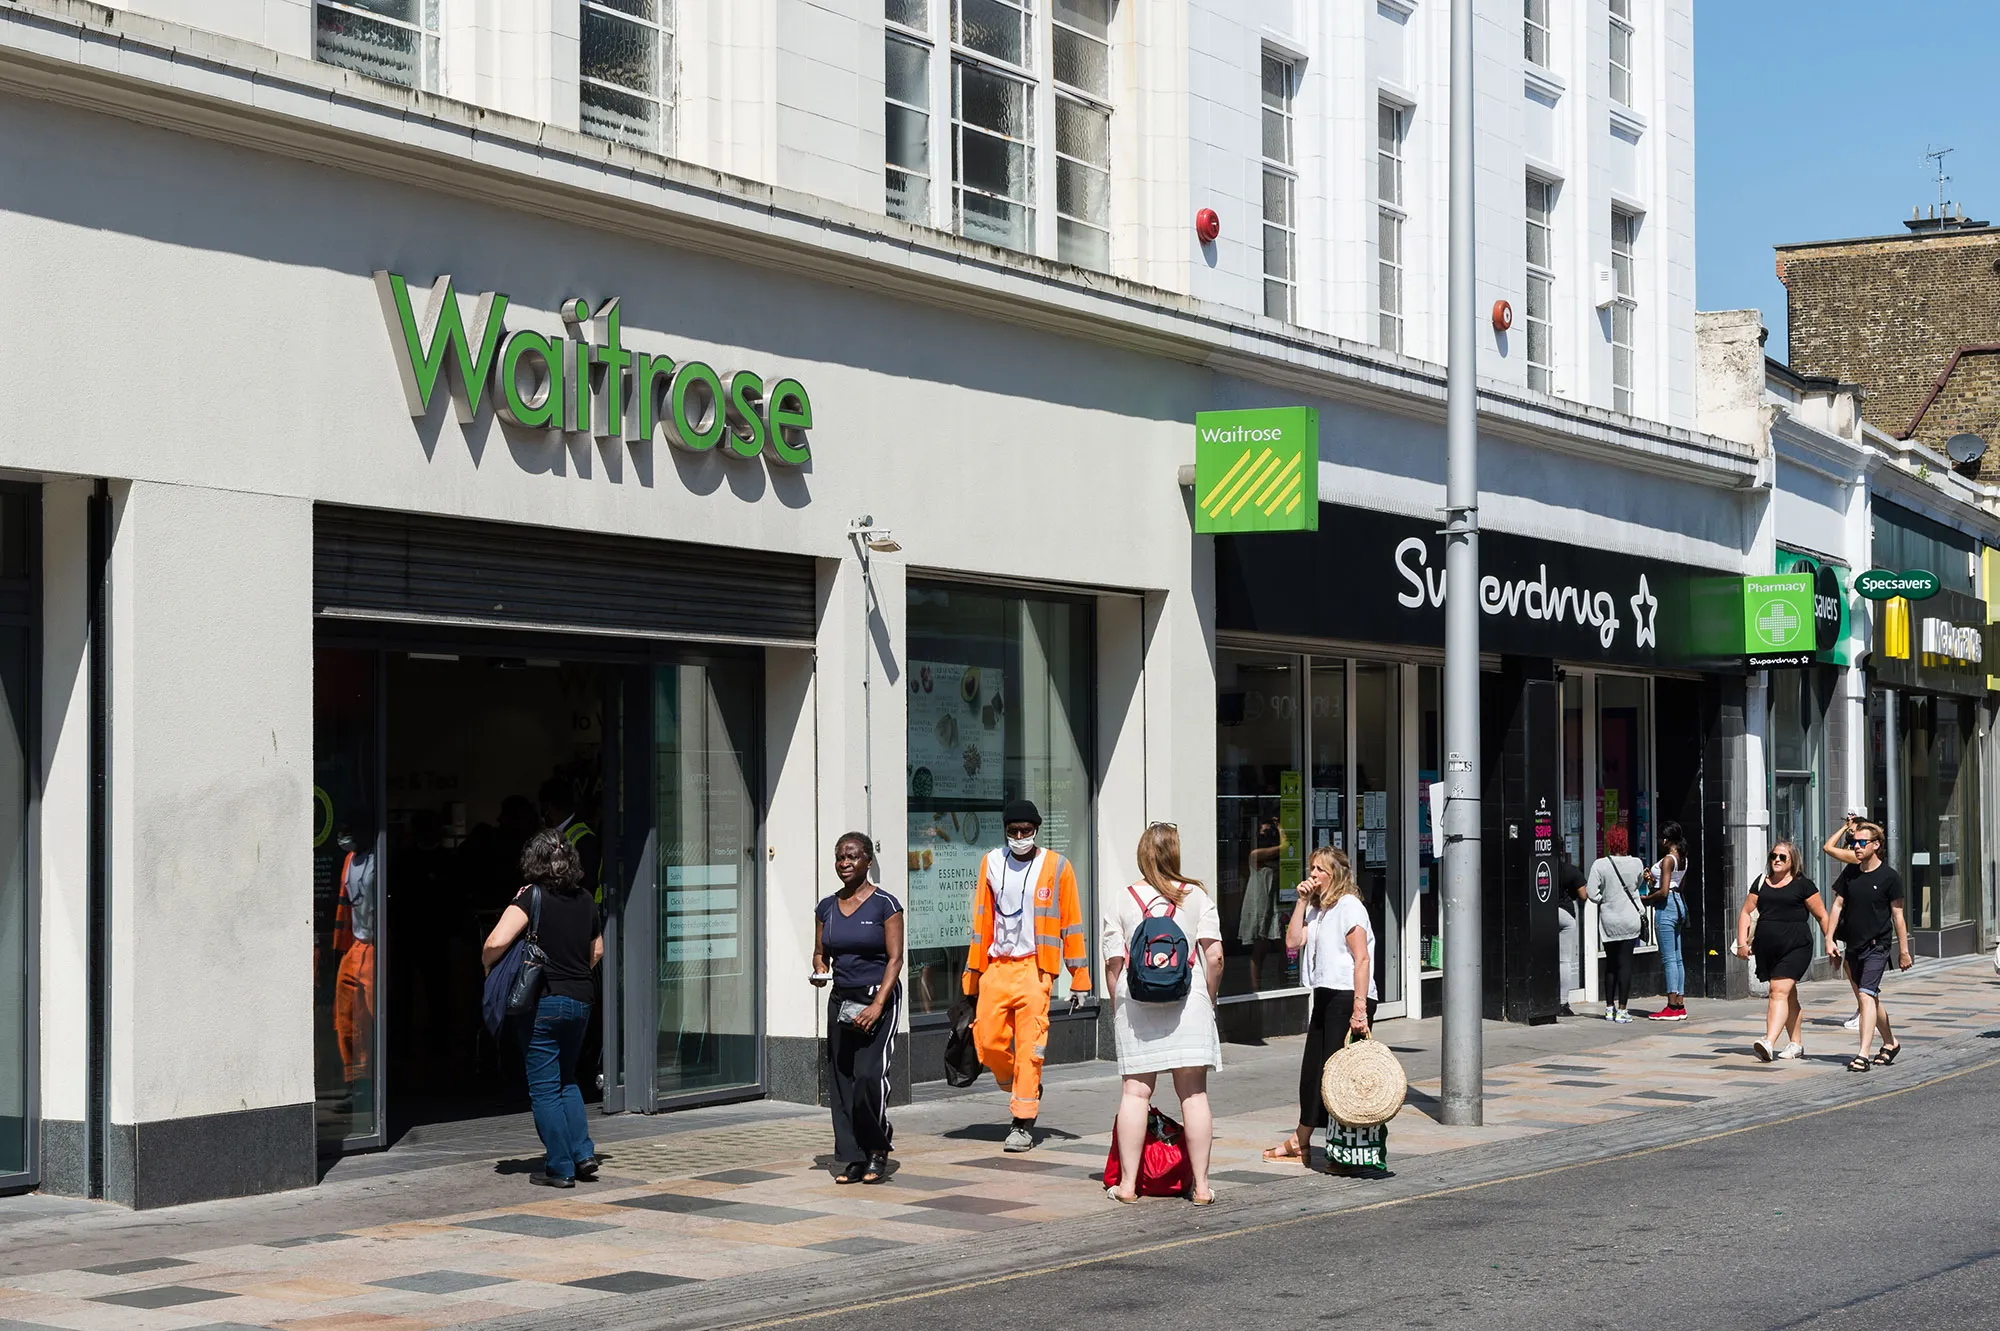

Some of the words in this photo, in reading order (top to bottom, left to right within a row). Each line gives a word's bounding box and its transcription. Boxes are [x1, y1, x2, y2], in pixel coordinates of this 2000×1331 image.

[375, 270, 813, 466] Waitrose
[1201, 425, 1282, 443] Waitrose
[1747, 582, 1806, 592] Pharmacy
[1862, 577, 1931, 592] Specsavers
[1394, 537, 1620, 648] Suerdrug
[1749, 657, 1798, 666] Superdrug
[1535, 825, 1551, 837] save
[1535, 839, 1551, 851] more
[938, 868, 977, 879] ESSENTIAL
[939, 880, 977, 891] WAITROSE
[938, 900, 971, 912] QUALITY
[949, 914, 954, 923] &
[940, 927, 963, 937] EVERY
